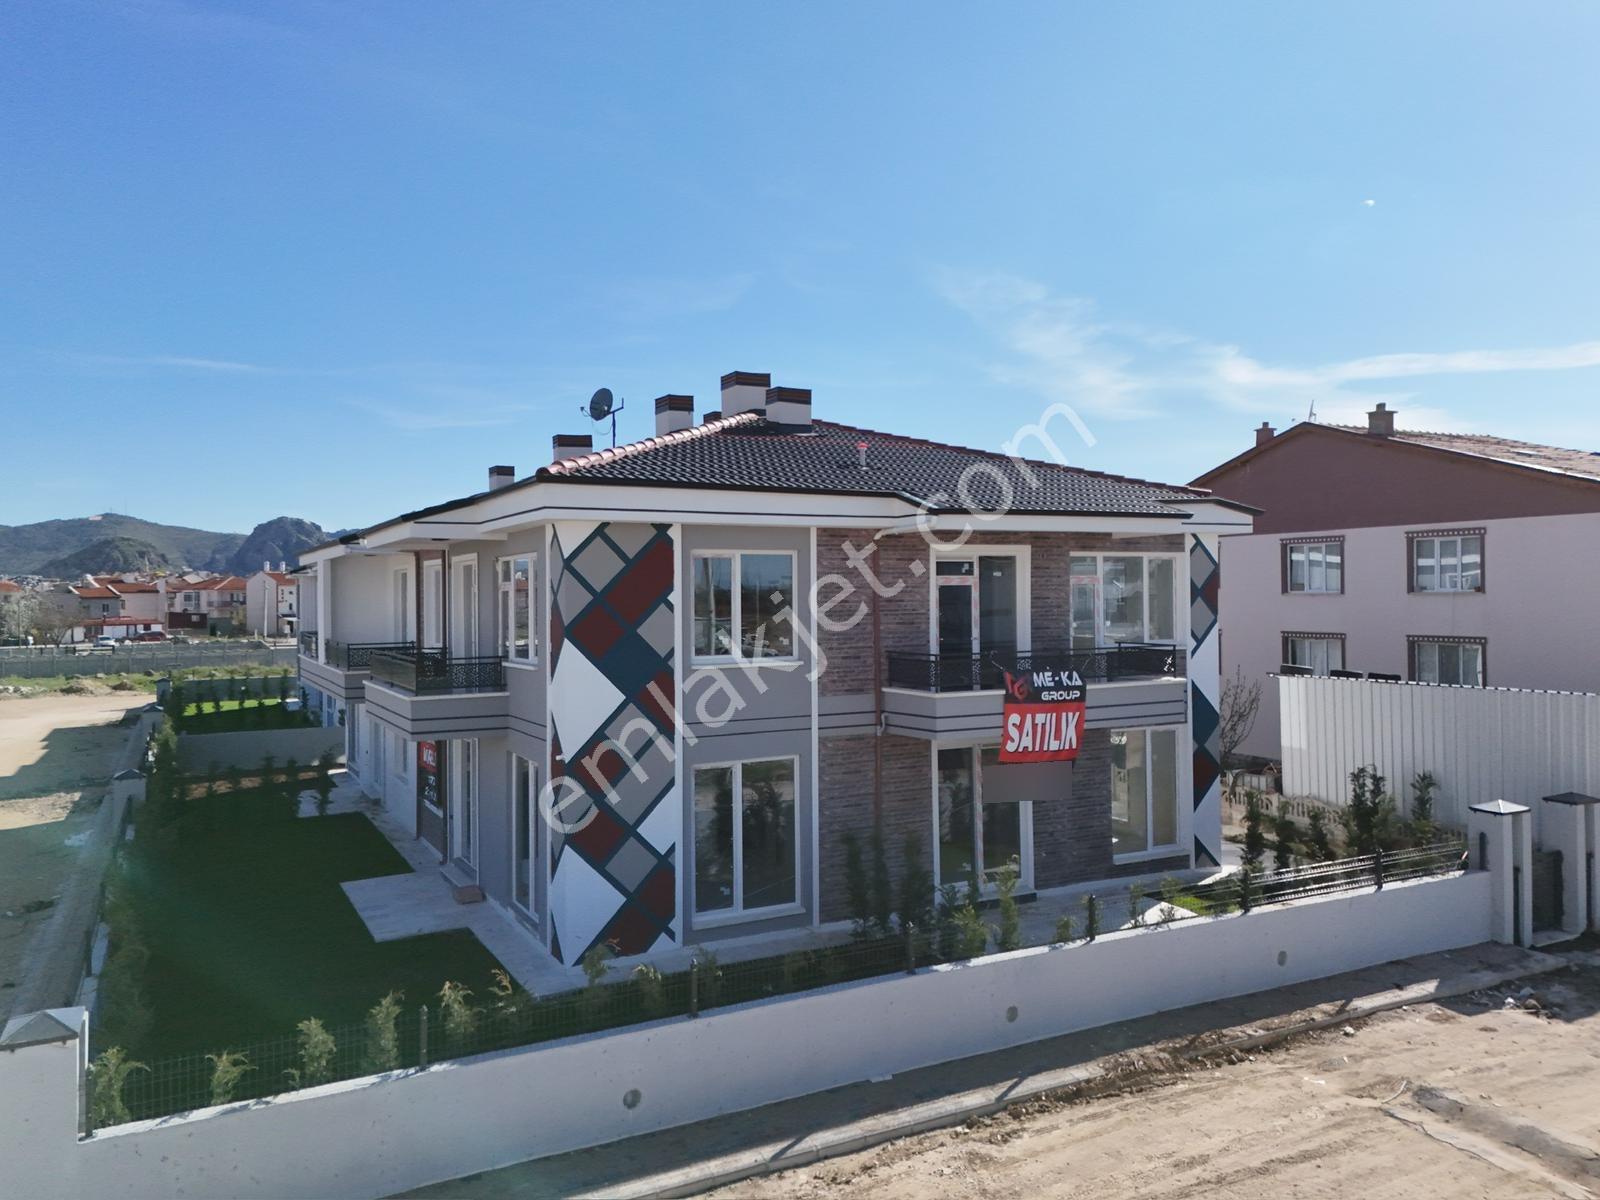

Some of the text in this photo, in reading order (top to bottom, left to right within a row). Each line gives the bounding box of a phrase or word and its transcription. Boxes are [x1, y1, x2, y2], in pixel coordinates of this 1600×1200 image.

[1033, 671, 1082, 687] ME-KA
[1041, 690, 1080, 700] GROUP
[1006, 712, 1079, 752] SATILIK
